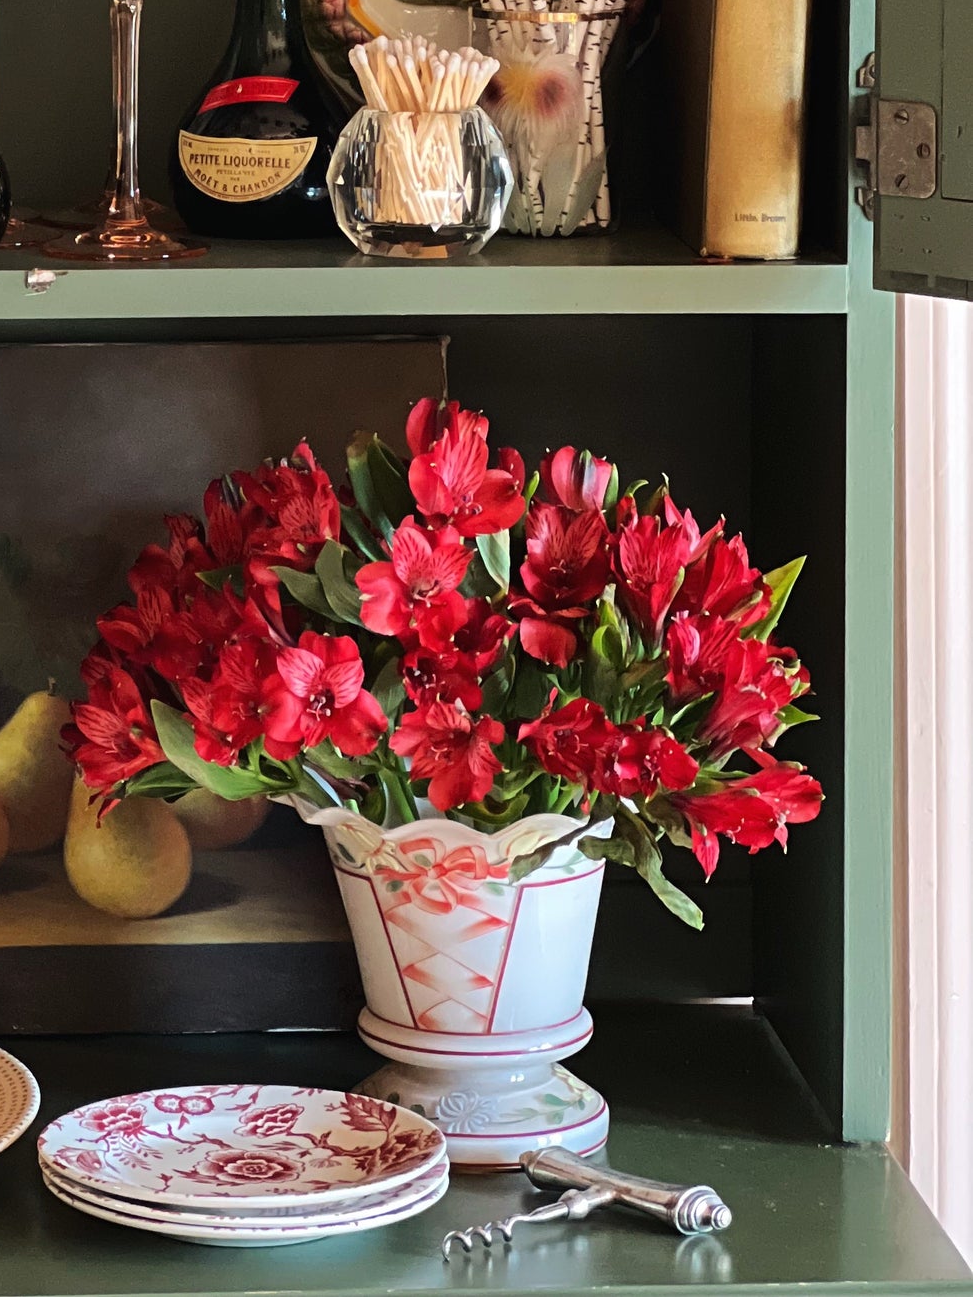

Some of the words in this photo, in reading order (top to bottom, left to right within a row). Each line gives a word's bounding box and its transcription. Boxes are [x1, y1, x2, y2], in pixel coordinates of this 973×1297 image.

[189, 153, 220, 165] PETITE
[223, 155, 291, 169] LIQUORELLE
[222, 184, 228, 192] &
[232, 171, 282, 193] CHANDON
